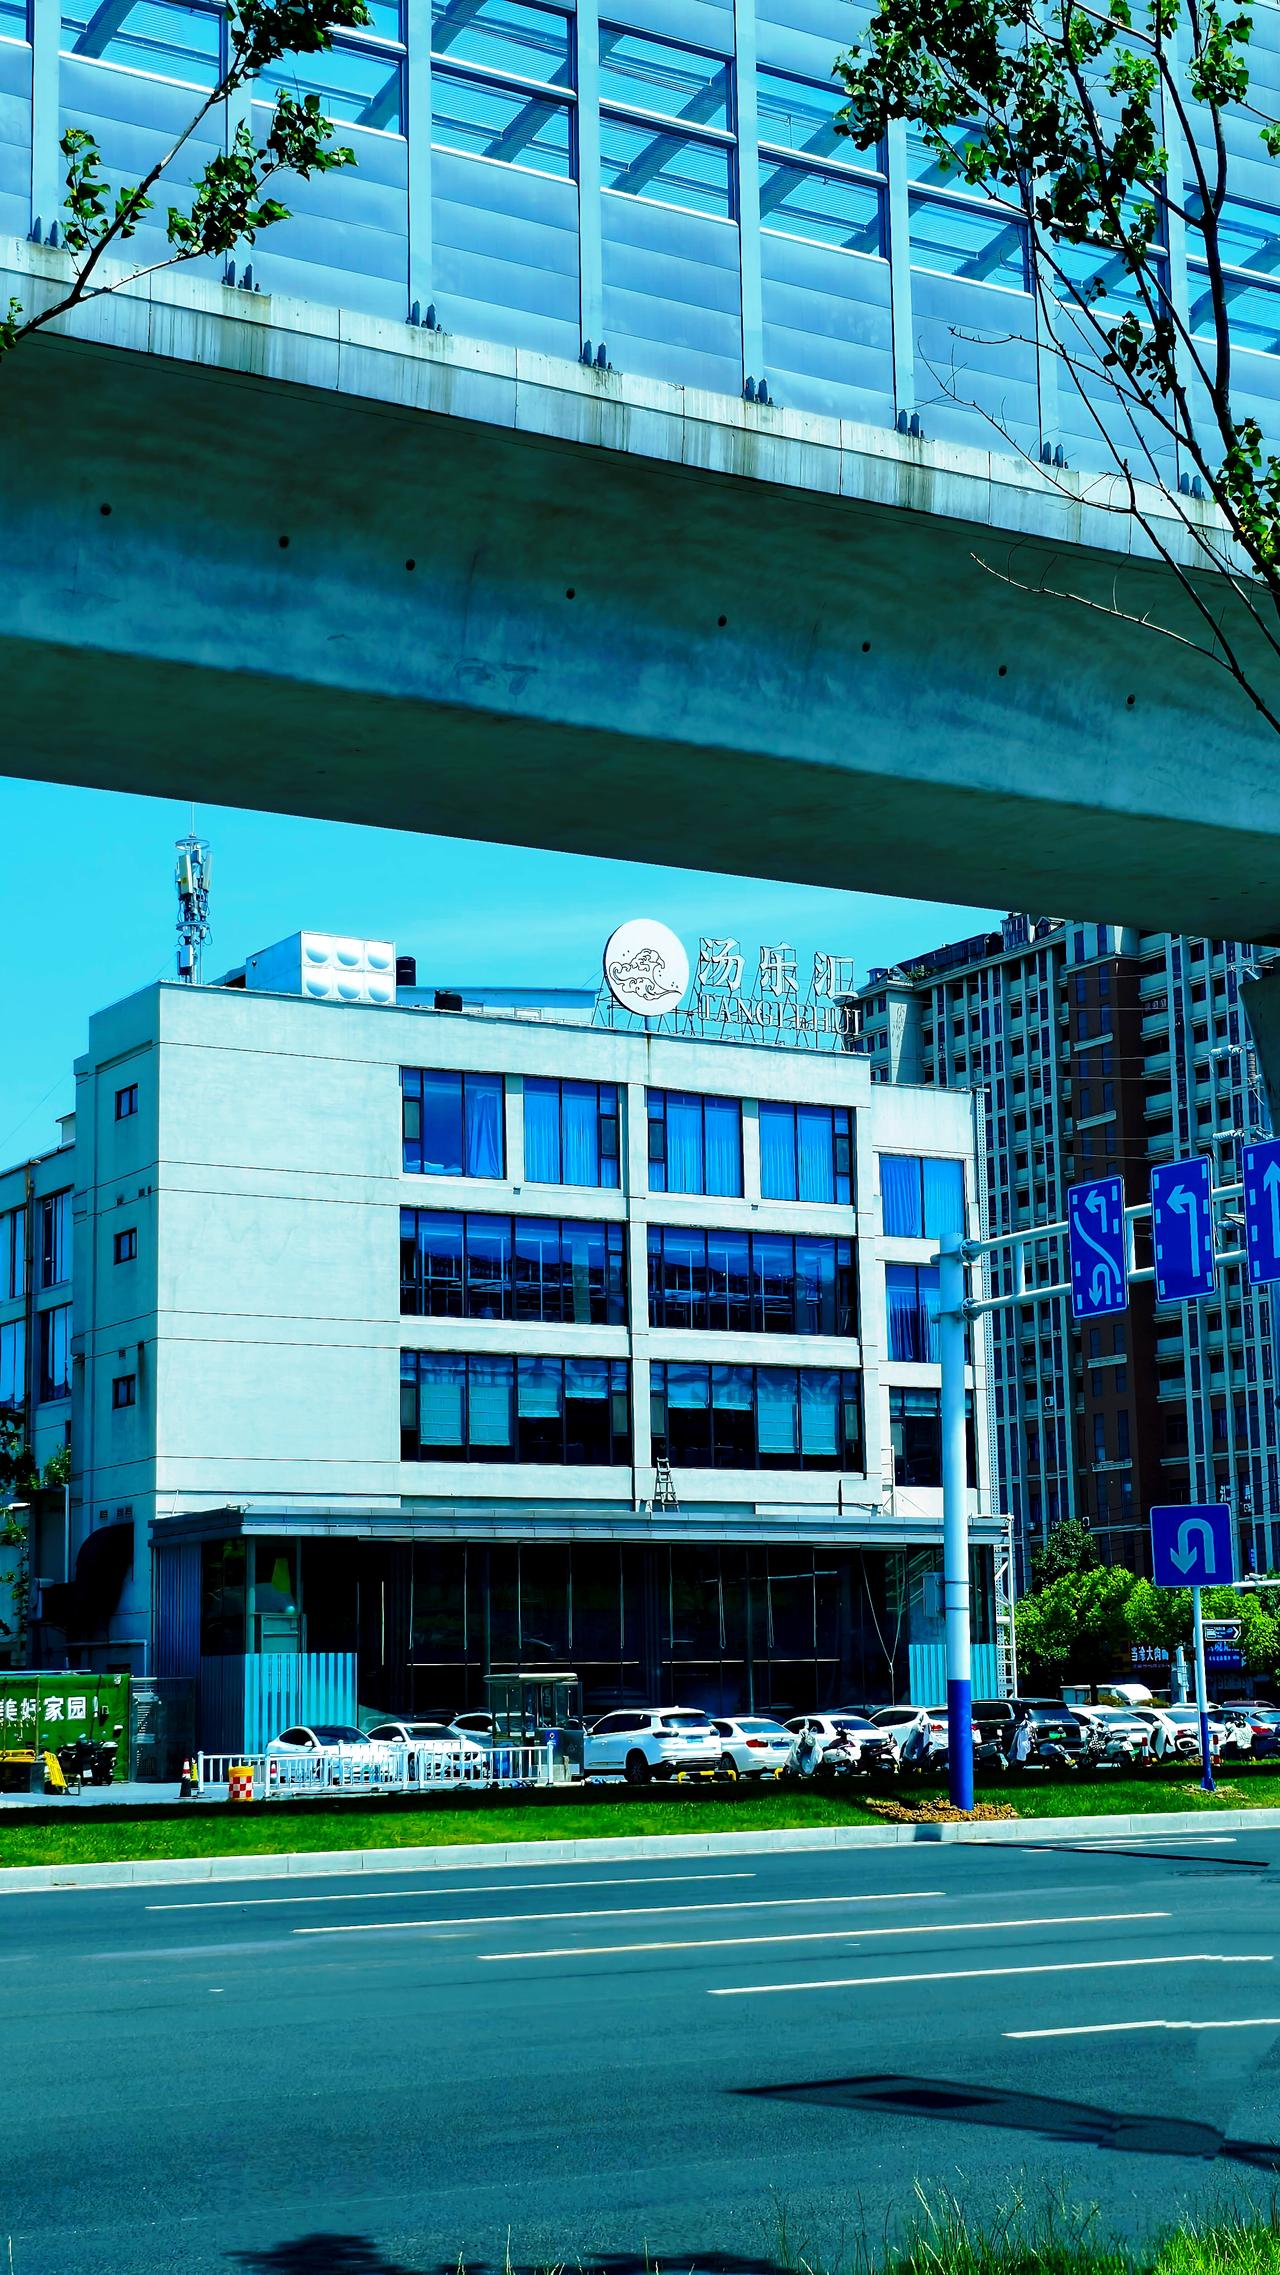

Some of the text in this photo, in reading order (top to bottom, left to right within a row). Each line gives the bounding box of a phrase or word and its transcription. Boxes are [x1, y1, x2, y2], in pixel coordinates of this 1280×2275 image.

[698, 937, 858, 999] 汤乐汇
[700, 993, 861, 1036] TANGLEHUI
